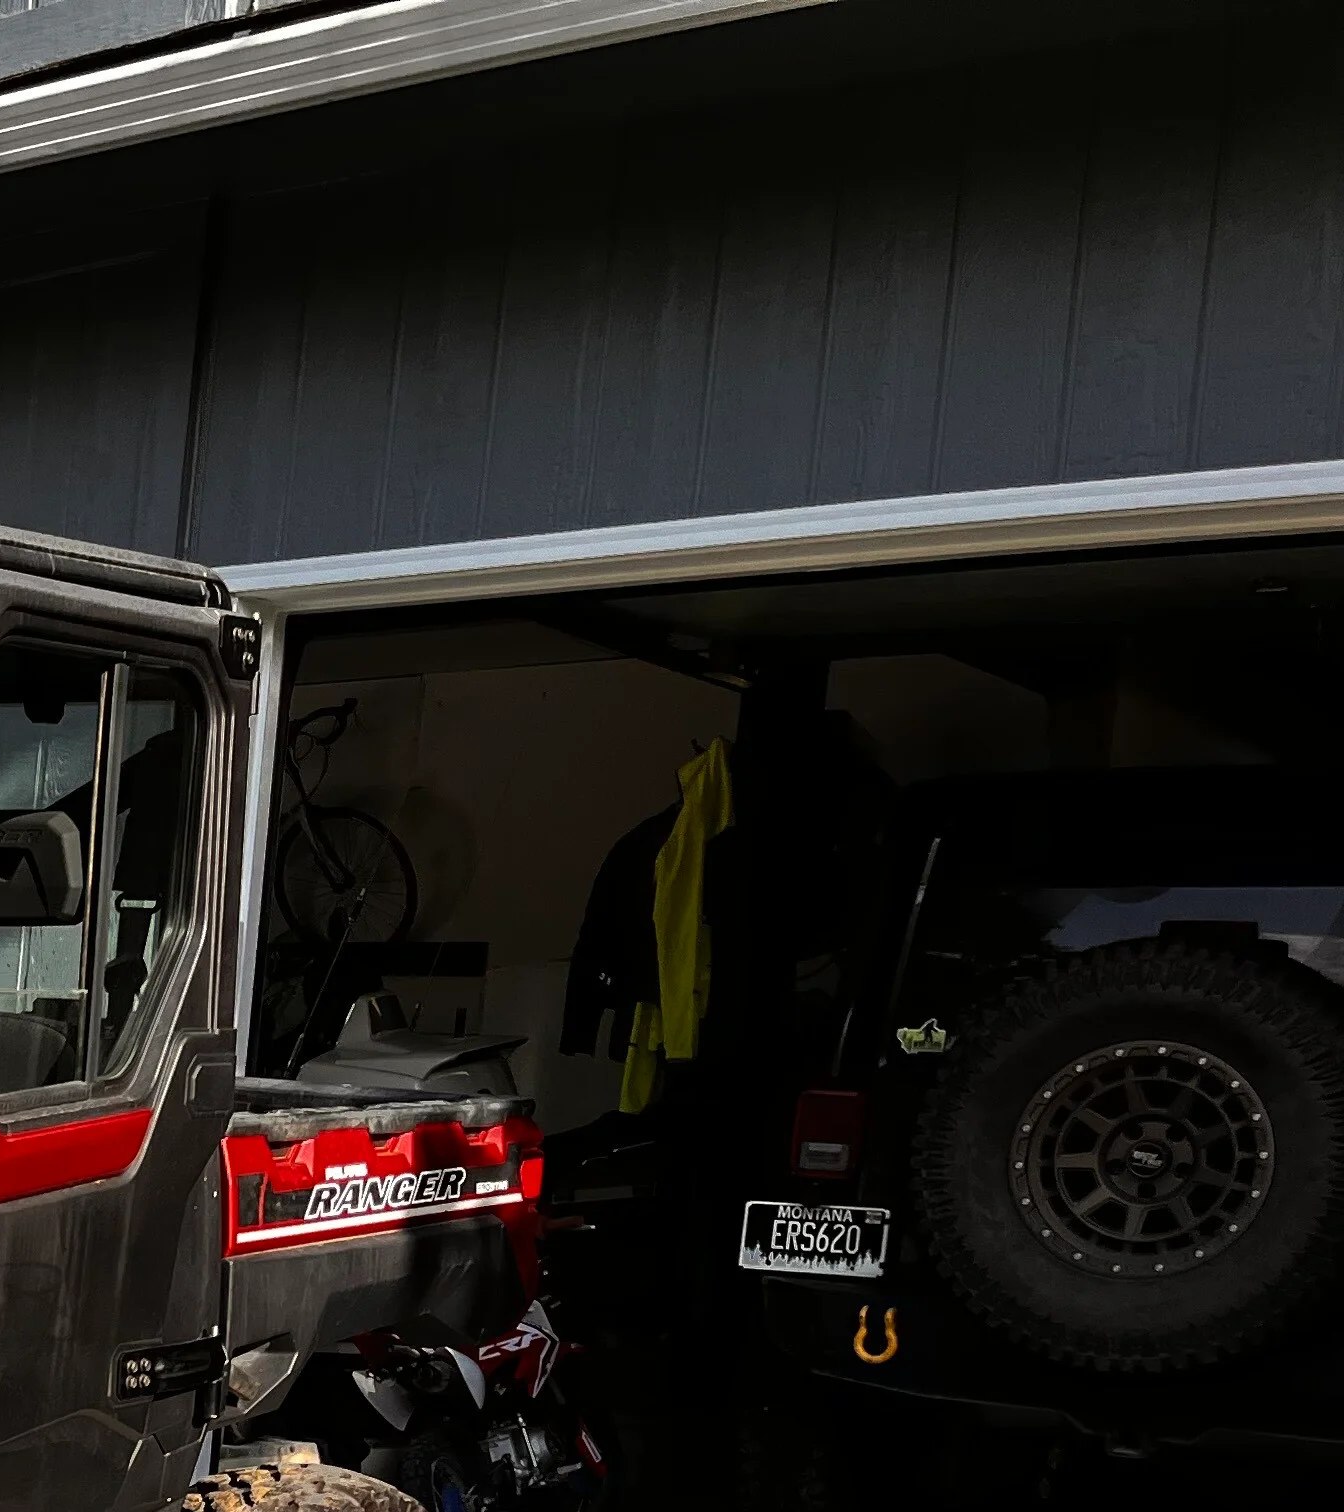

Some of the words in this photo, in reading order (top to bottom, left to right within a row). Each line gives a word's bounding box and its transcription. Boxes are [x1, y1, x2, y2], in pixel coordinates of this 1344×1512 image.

[303, 1166, 467, 1221] RANGER
[777, 1205, 854, 1223] MONTANA
[771, 1219, 862, 1255] ERS620
